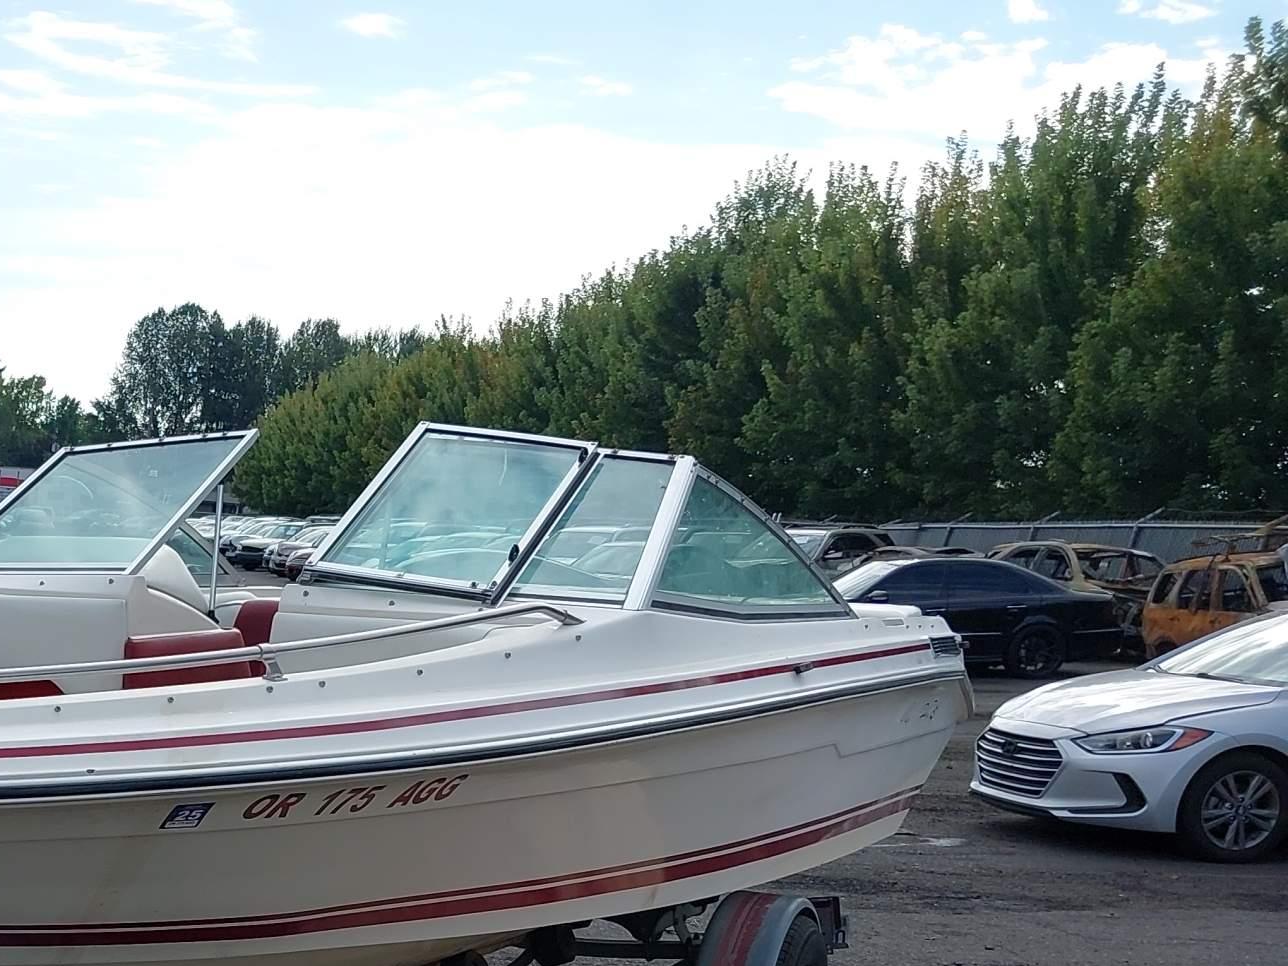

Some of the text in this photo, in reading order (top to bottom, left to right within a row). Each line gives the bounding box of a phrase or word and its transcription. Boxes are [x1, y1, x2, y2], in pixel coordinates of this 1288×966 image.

[242, 773, 470, 820] OR 175 AGG
[174, 809, 203, 821] 25
